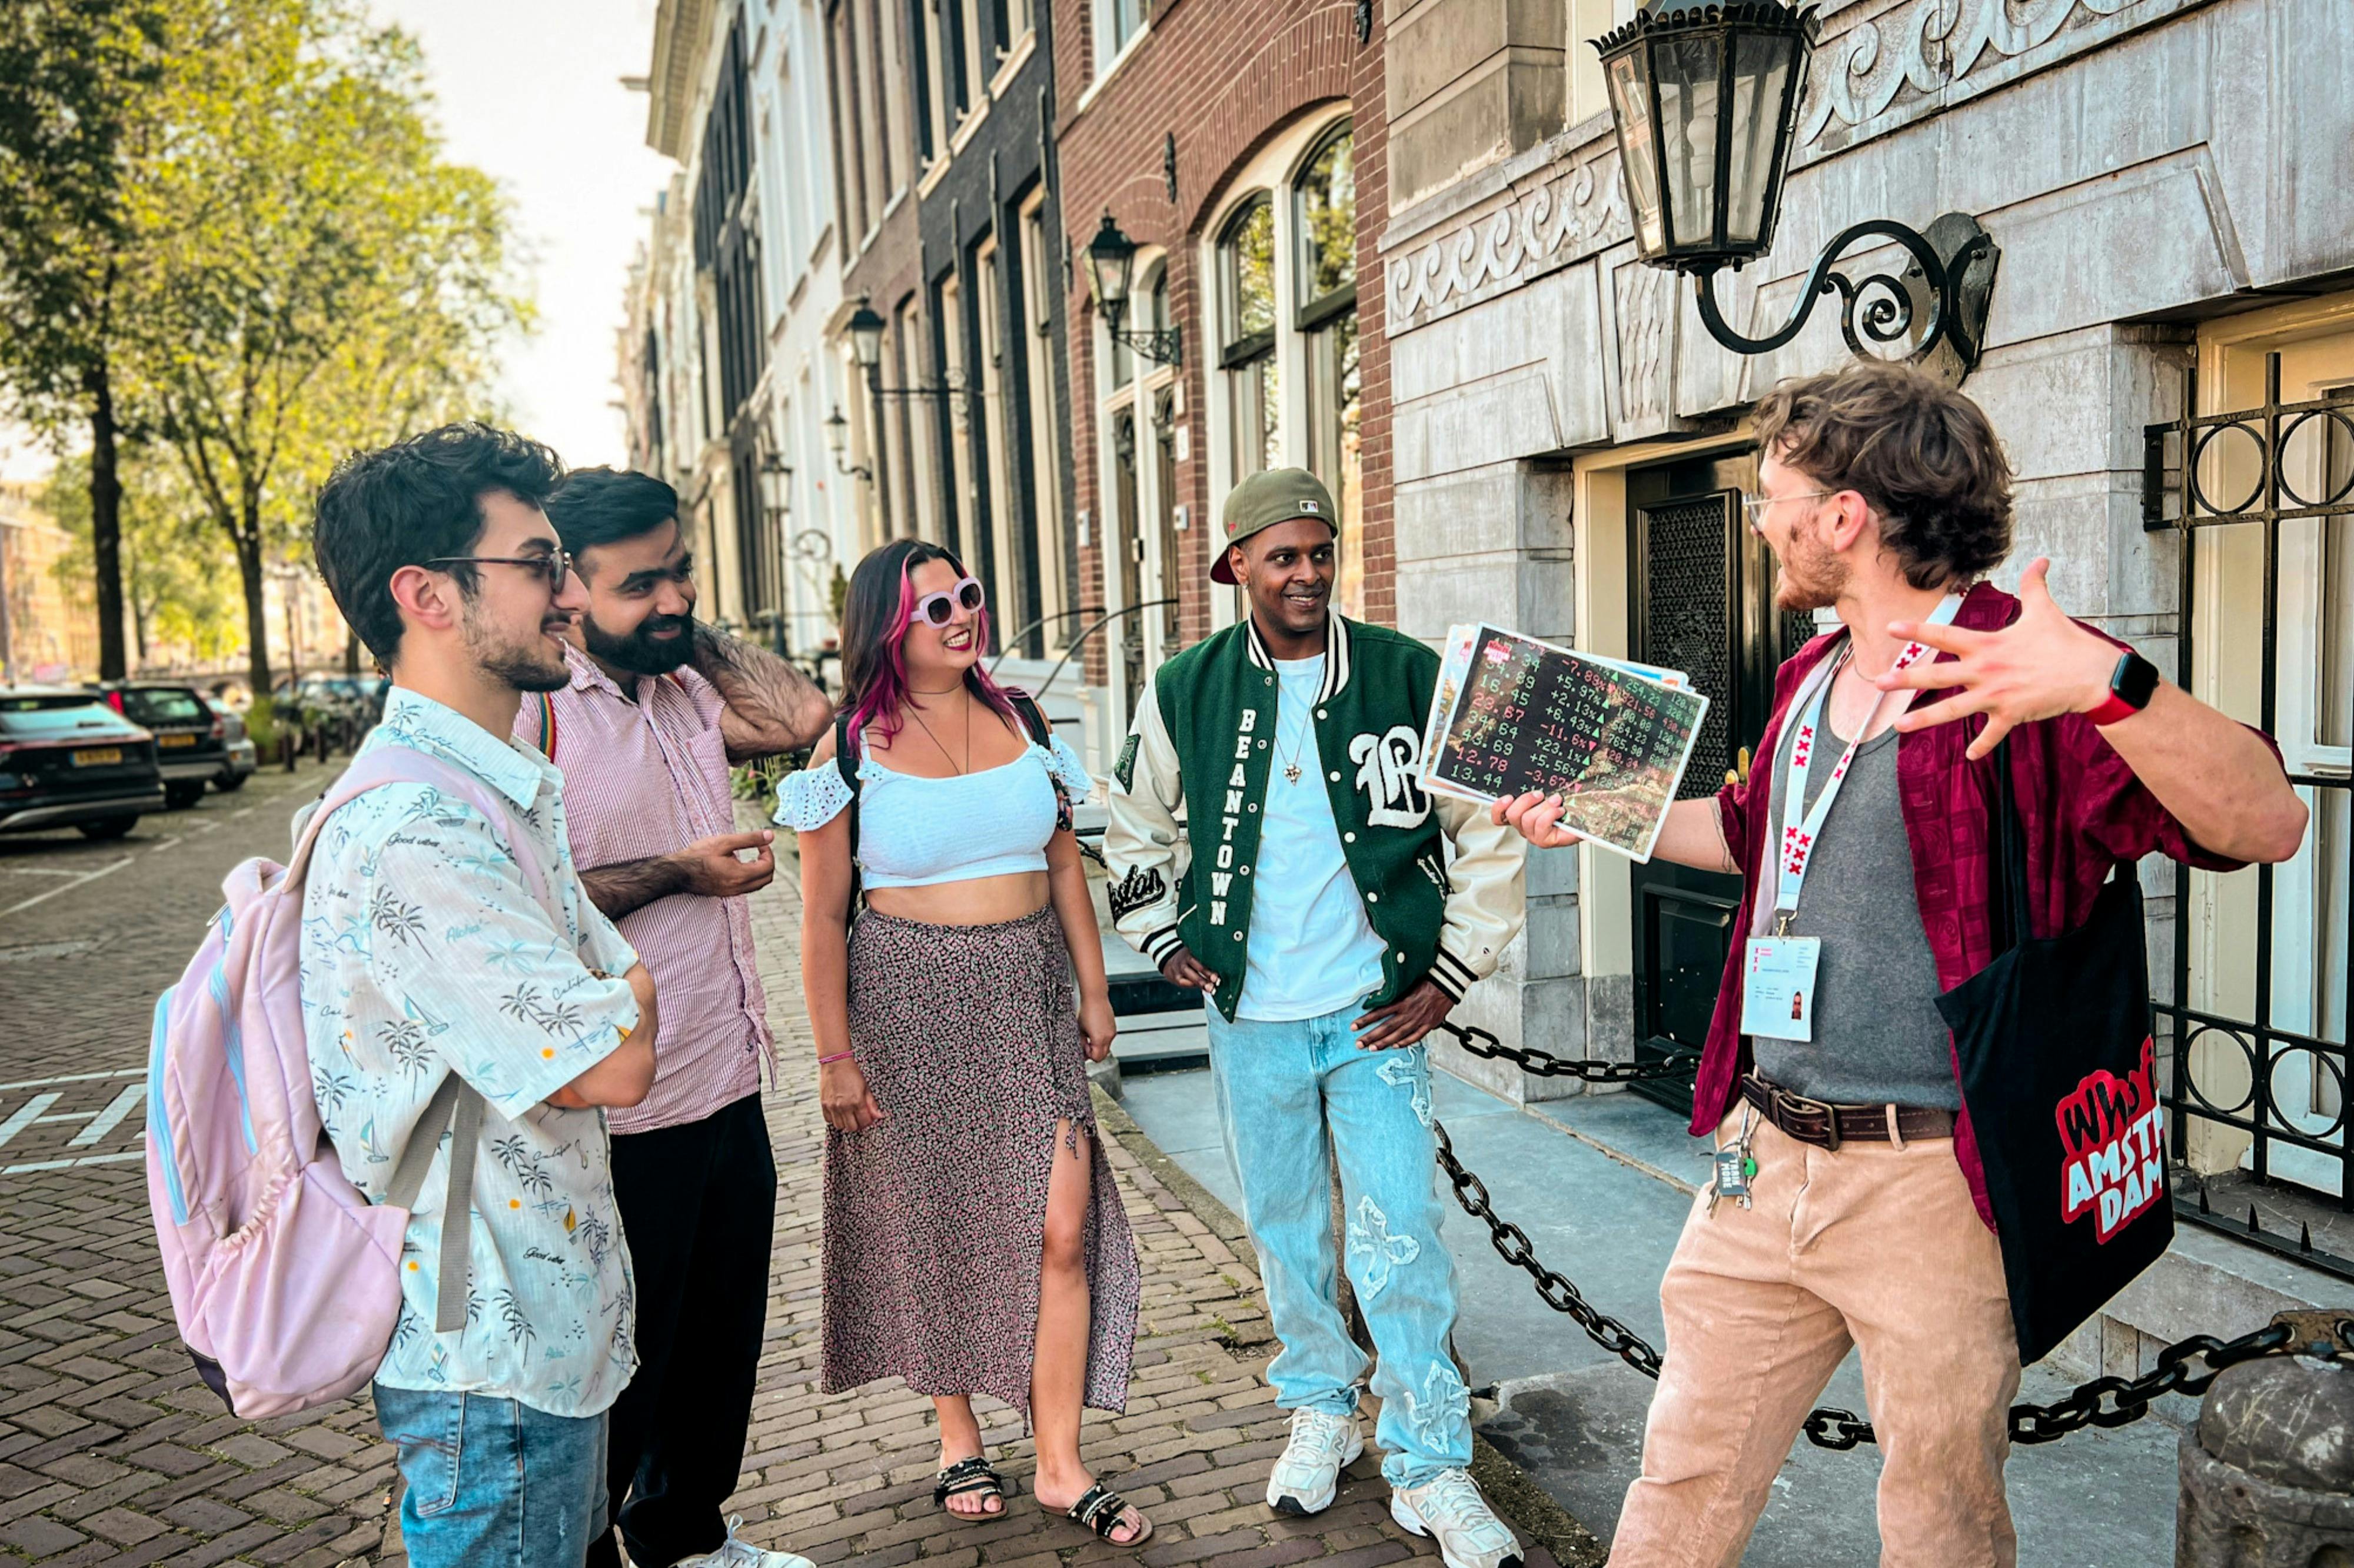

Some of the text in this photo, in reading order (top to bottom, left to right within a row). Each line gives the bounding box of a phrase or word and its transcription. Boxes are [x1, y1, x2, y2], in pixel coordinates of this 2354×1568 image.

[1480, 674, 1531, 706] 16.45
[1545, 705, 1592, 734] +6.43%
[1551, 690, 1597, 720] +2.13%
[1556, 673, 1602, 706] +5.97%
[1468, 710, 1518, 740] 34.64
[1534, 737, 1582, 763] +23.1%
[1472, 691, 1525, 723] 23.67
[1540, 723, 1587, 749] -11.6%
[1451, 764, 1502, 788] 13.44
[1456, 746, 1508, 773] 12.78
[1462, 728, 1514, 756] 43.69
[1530, 753, 1577, 777] +5.56%
[1209, 708, 1258, 926] BEANTOWN
[2063, 1080, 2140, 1152] Who
[2099, 1147, 2163, 1234] DAM
